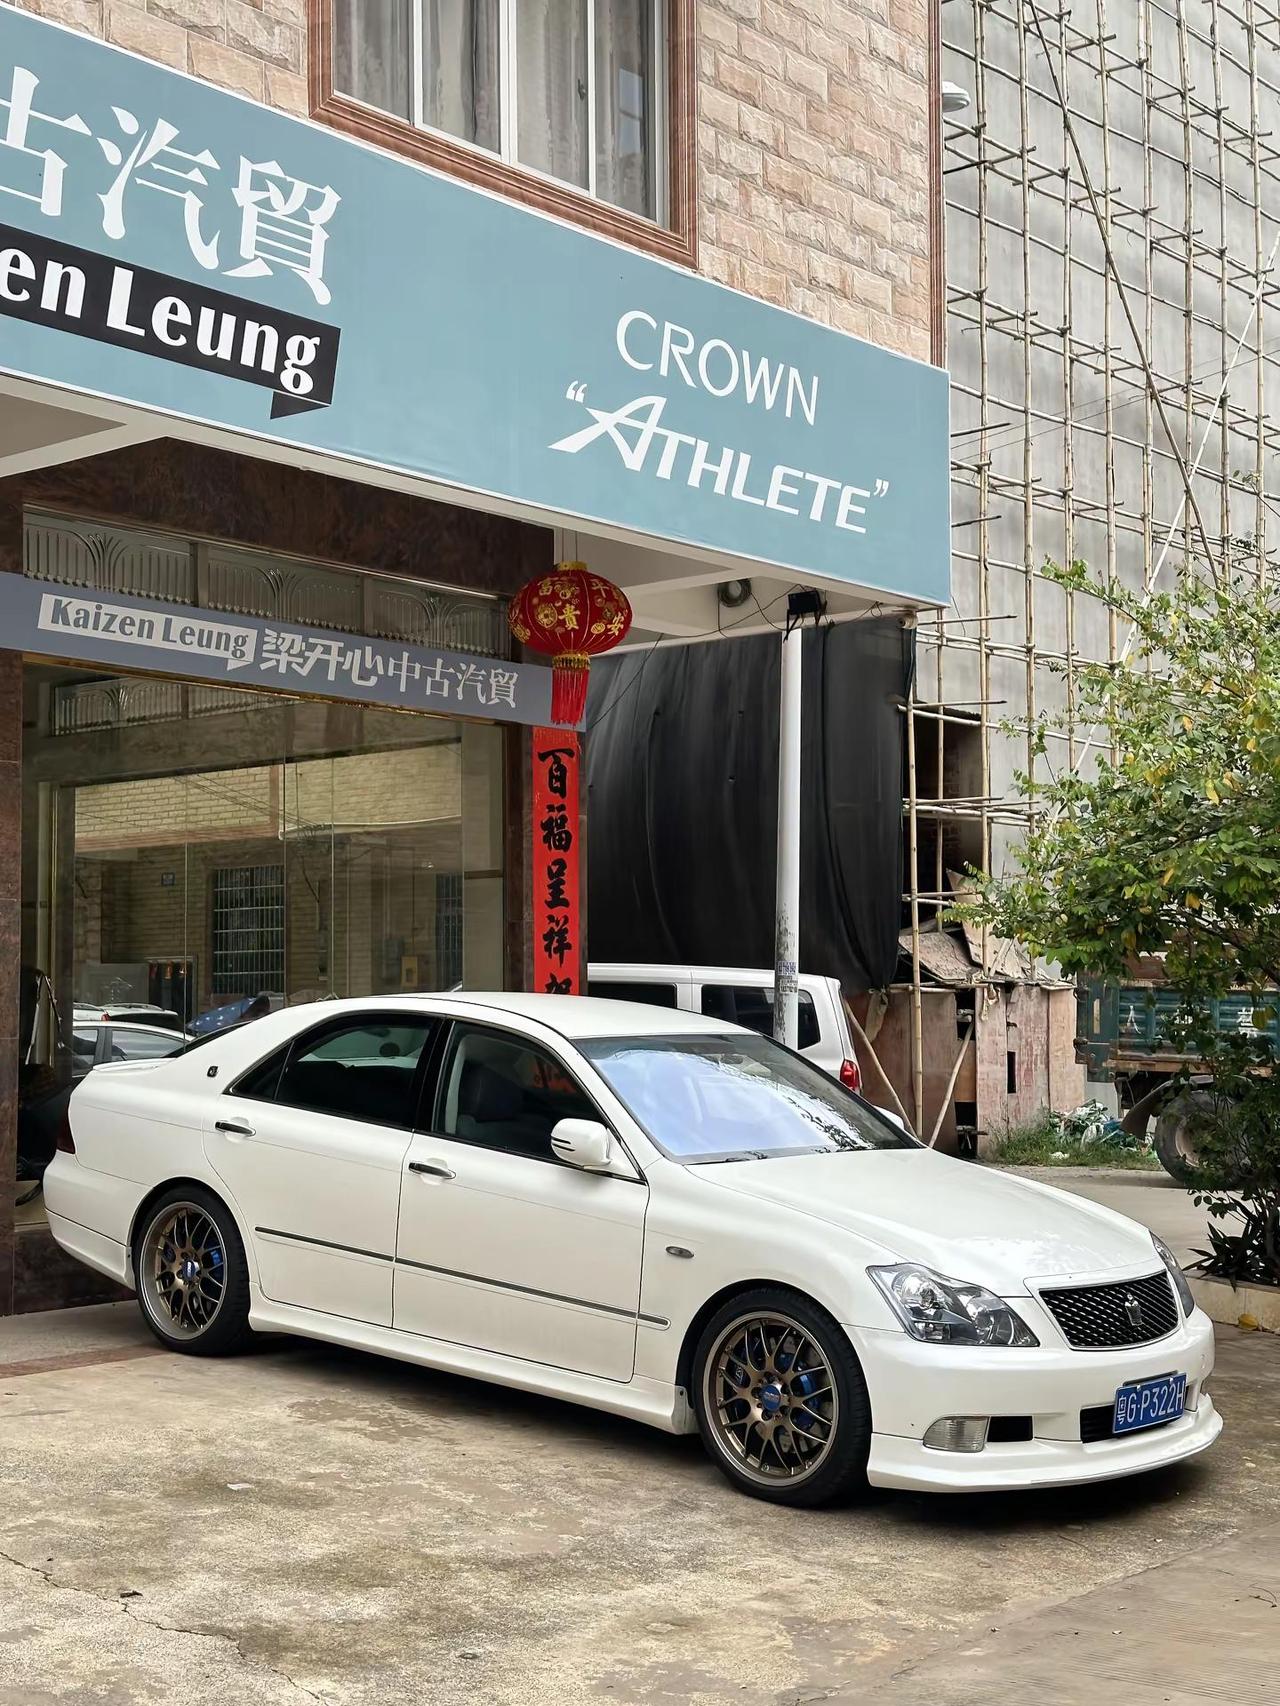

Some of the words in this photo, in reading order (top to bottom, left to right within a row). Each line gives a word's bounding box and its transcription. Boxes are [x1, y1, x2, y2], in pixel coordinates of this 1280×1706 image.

[106, 266, 320, 395] Leung
[616, 310, 819, 426] CROWN
[51, 598, 155, 640] Kaizen
[162, 617, 249, 659] Leung
